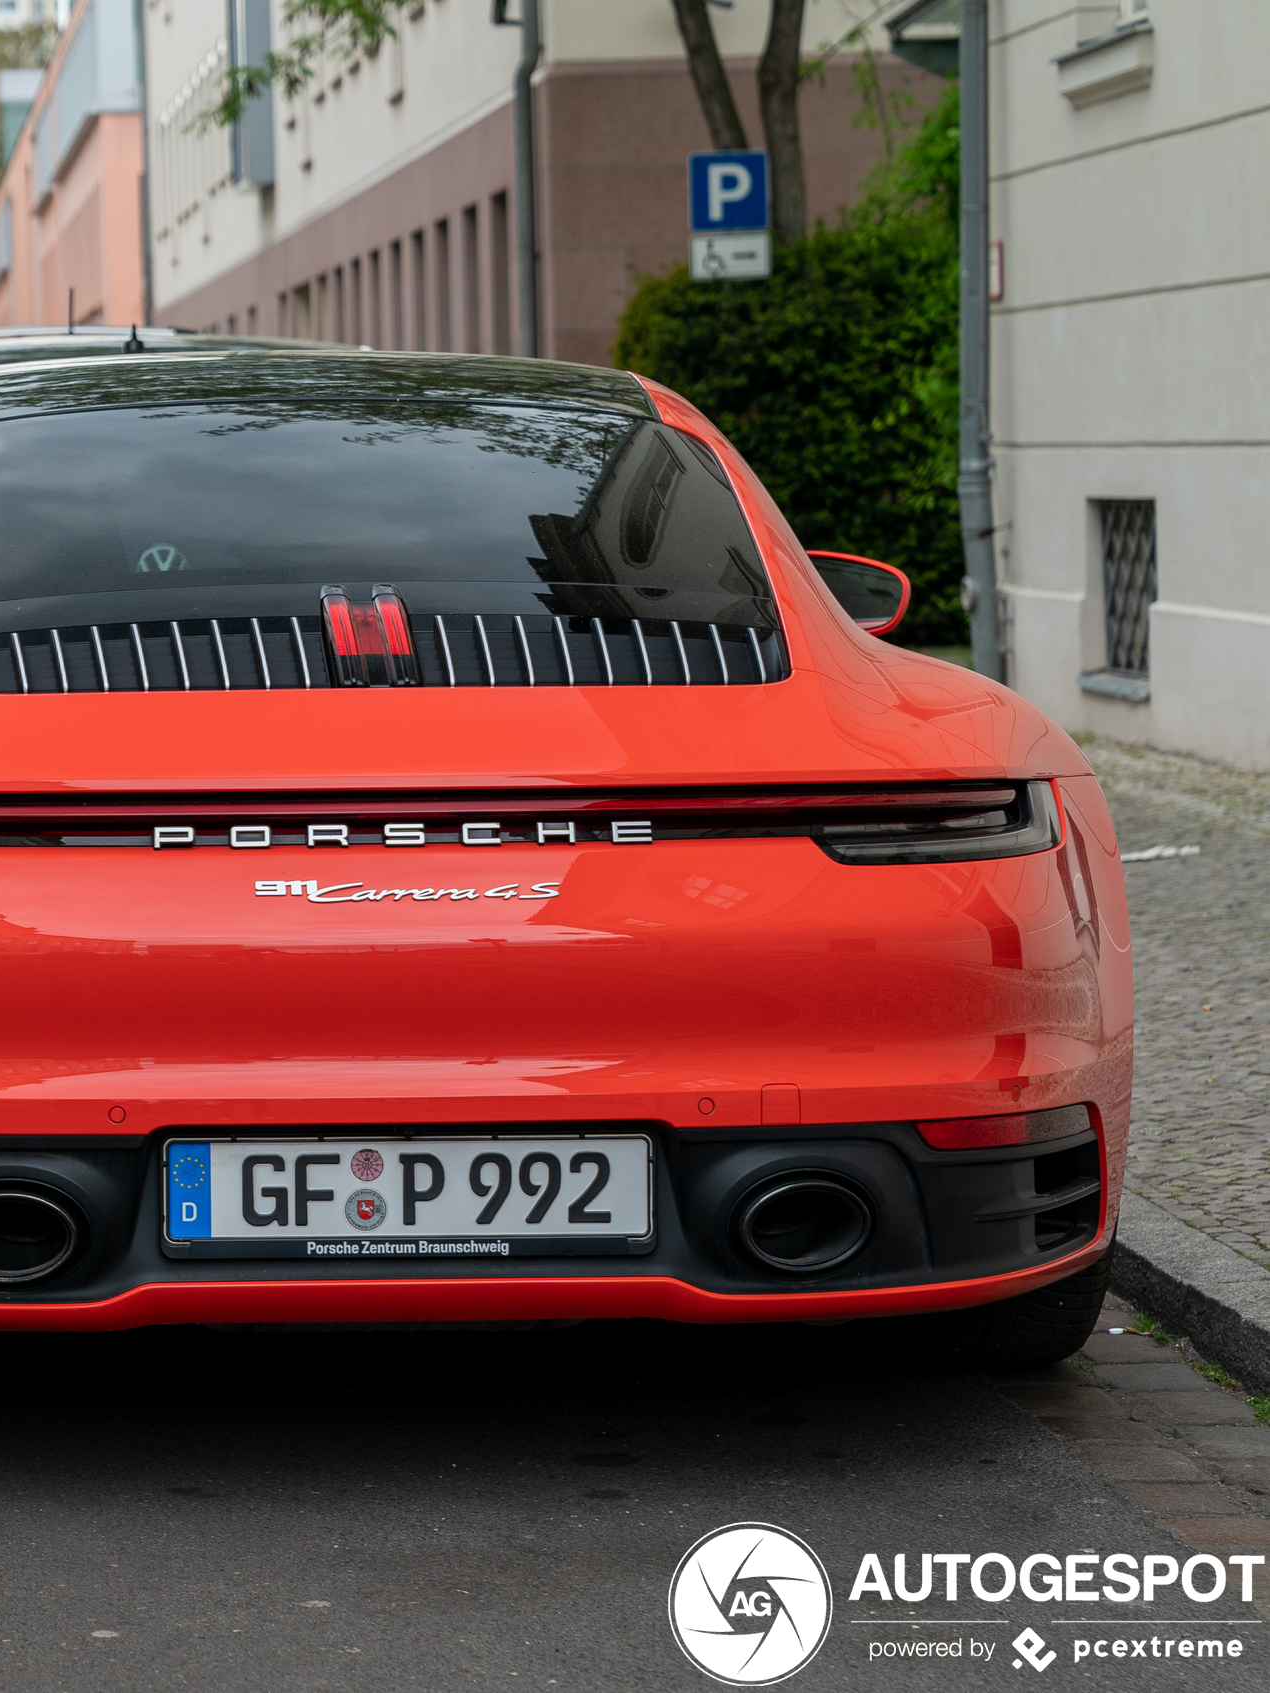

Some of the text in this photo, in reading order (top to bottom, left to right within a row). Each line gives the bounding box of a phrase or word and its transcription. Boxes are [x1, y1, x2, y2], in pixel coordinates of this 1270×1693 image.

[707, 162, 753, 222] P
[153, 821, 653, 849] PORSCHE
[254, 880, 318, 897] 911
[307, 881, 480, 903] Carrera
[241, 1153, 341, 1227] GF
[398, 1153, 445, 1226] P
[468, 1151, 612, 1225] 992
[182, 1201, 197, 1222] D
[306, 1240, 509, 1256] Porsche Zentrum Braunschweig
